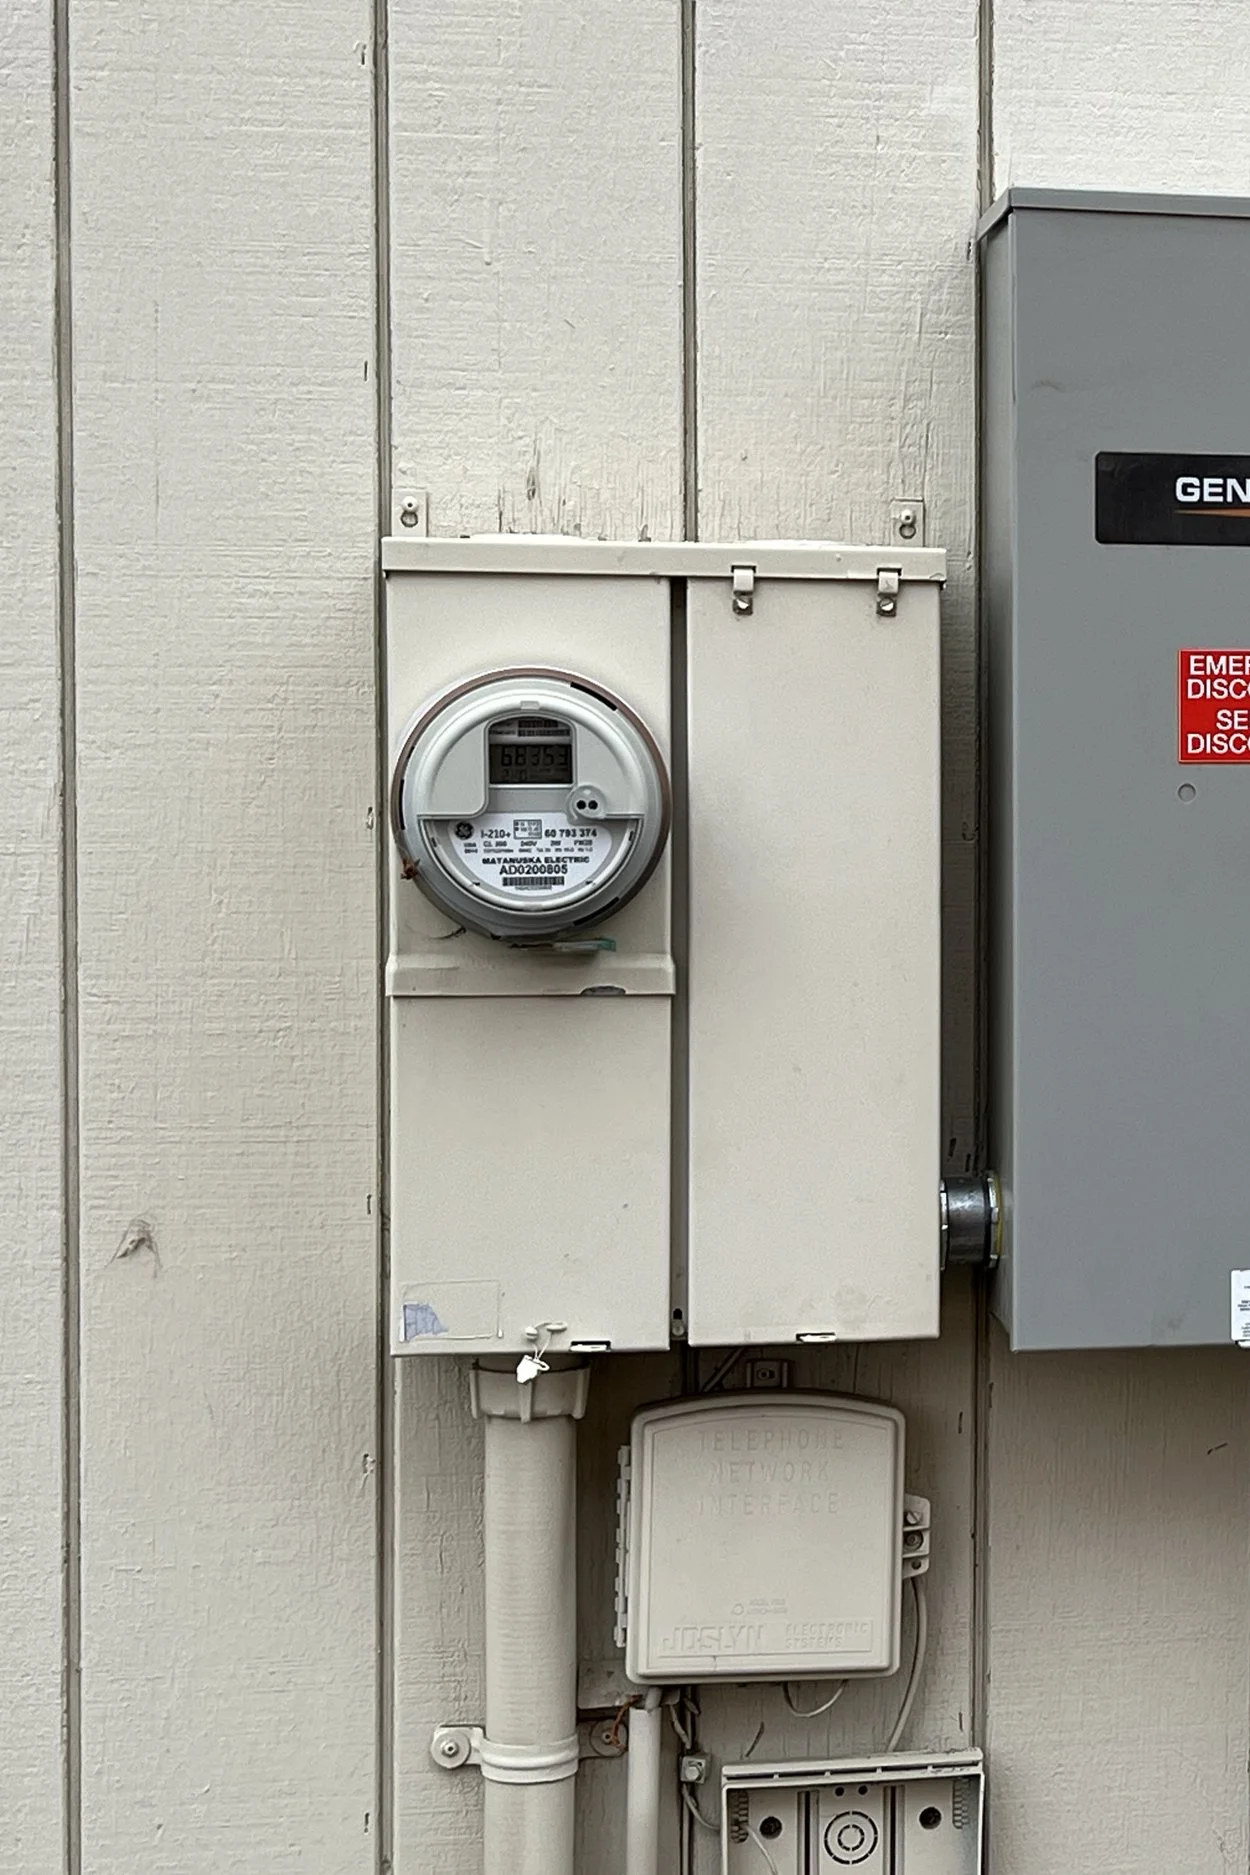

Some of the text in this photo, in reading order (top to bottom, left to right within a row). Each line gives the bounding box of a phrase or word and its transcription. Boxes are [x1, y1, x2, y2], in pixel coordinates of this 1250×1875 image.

[482, 856, 590, 865] MATANUSKA ELECTRIC
[499, 864, 568, 875] AD0200805
[698, 1428, 846, 1452] TELEPHONE
[709, 1460, 831, 1484] NETWORK
[697, 1492, 841, 1516] INTERFACE
[662, 1624, 766, 1650] JOSLYN
